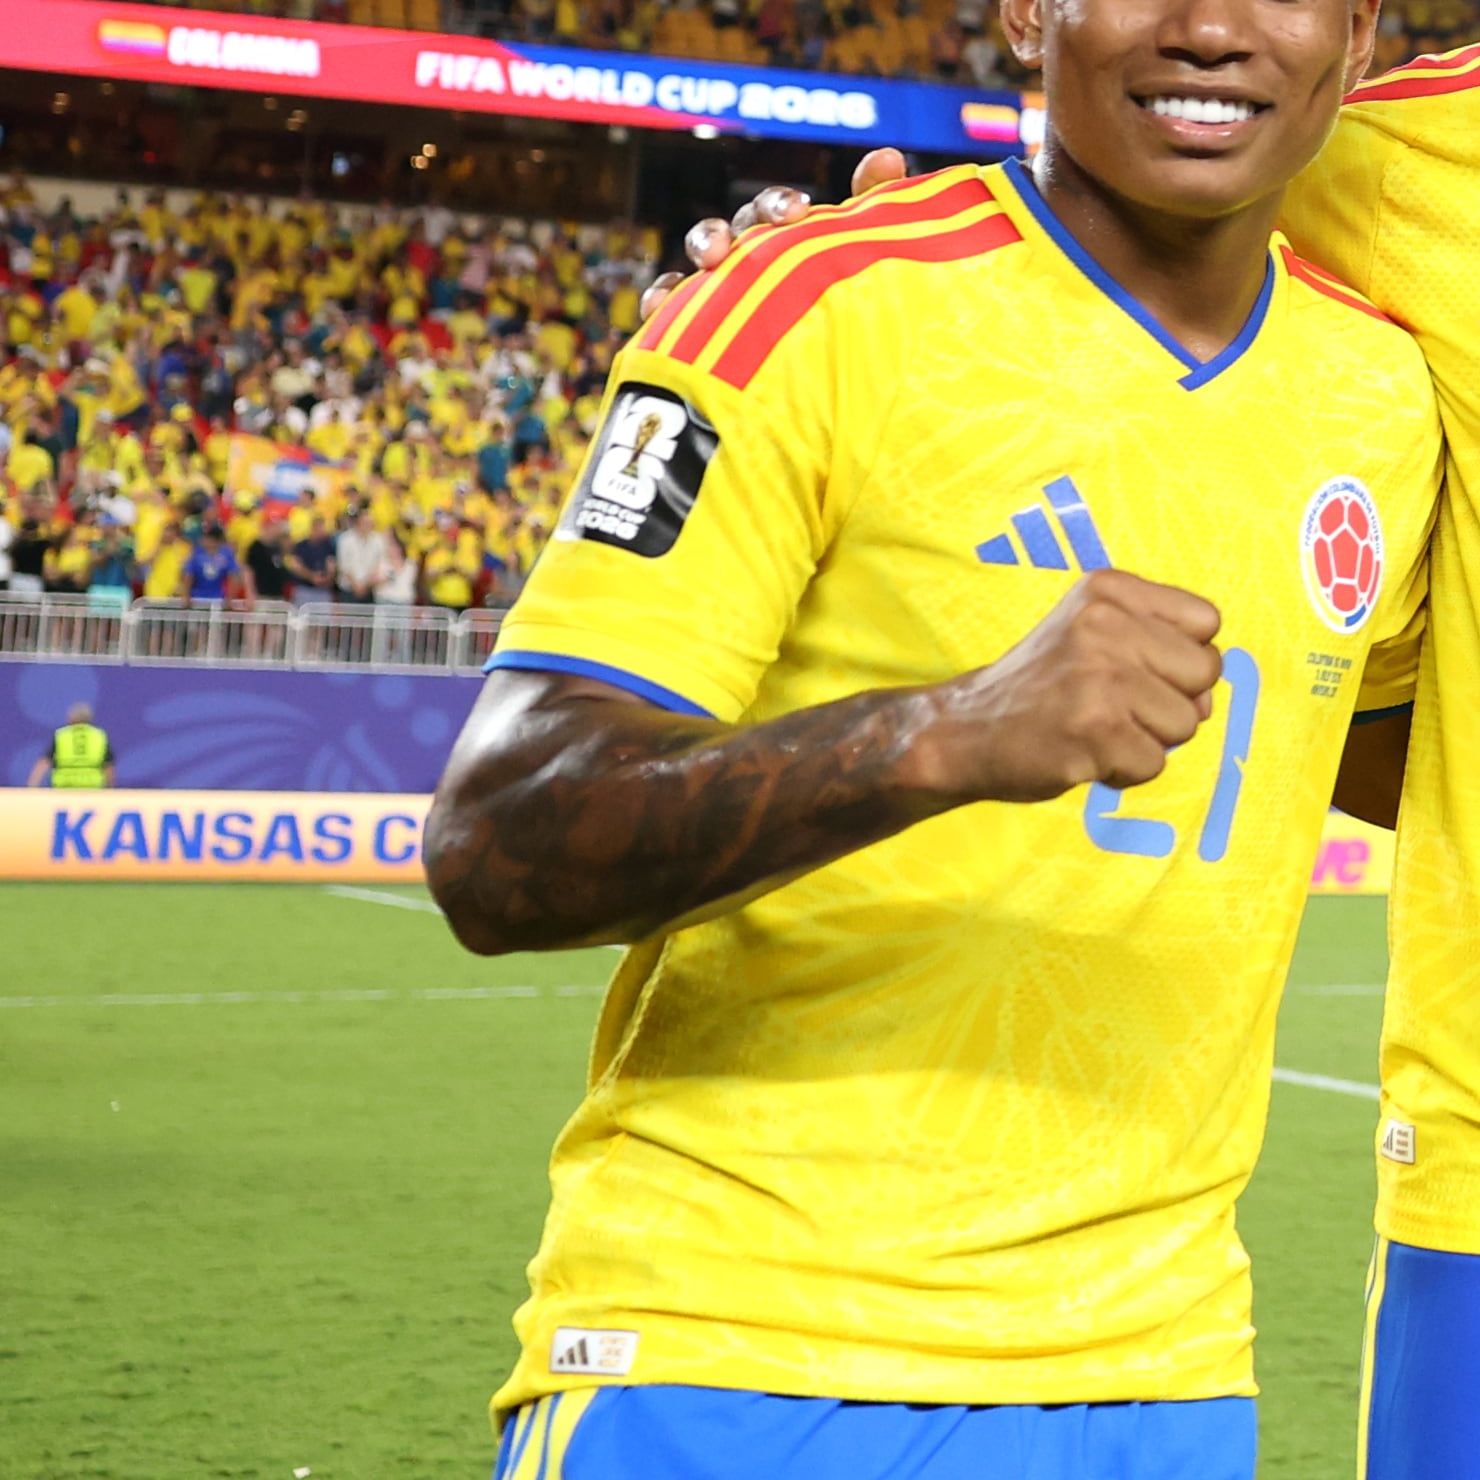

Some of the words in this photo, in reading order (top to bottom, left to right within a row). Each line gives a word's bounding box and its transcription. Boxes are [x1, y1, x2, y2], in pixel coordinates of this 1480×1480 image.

[415, 51, 506, 94] FIFA
[507, 61, 655, 107] WORLD
[656, 74, 738, 116] CUP
[738, 83, 878, 128] 2026
[607, 478, 638, 497] FIFA
[575, 509, 640, 541] 2026
[50, 809, 356, 864] KANSAS
